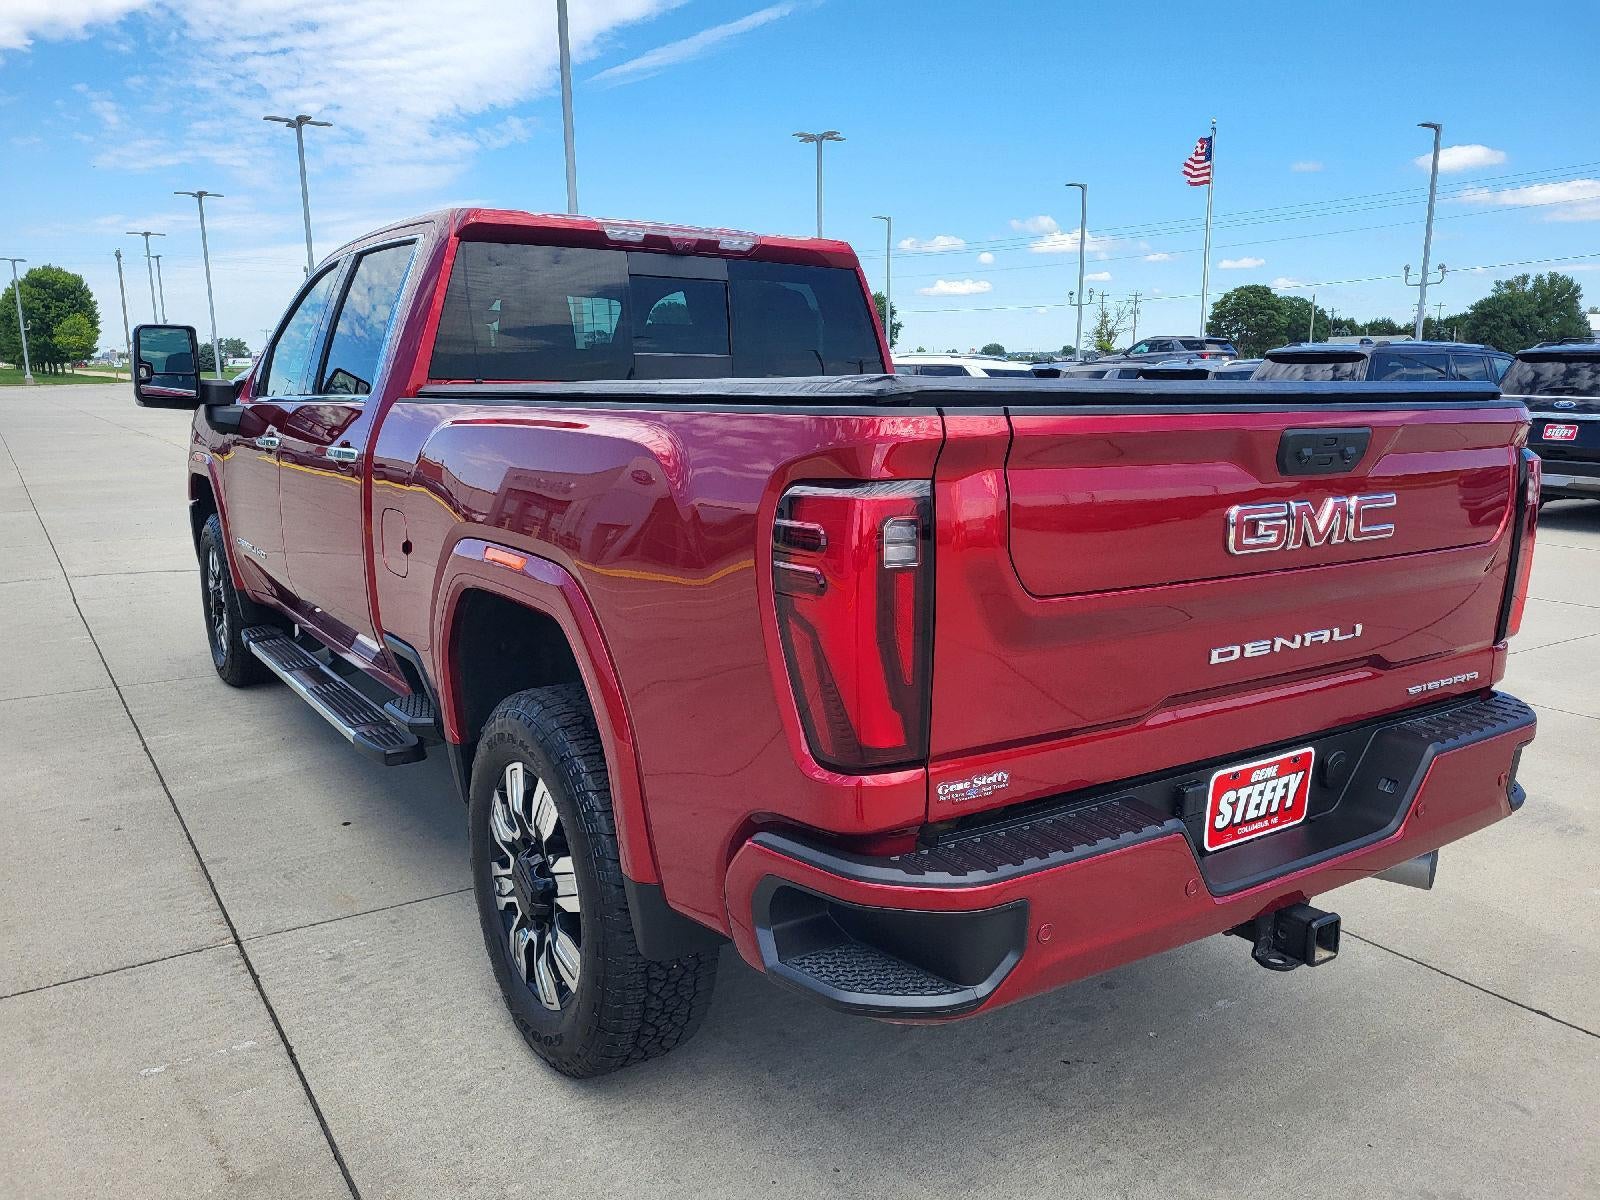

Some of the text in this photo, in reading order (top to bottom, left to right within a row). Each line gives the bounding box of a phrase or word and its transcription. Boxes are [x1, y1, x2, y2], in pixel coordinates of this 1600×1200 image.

[1546, 428, 1574, 436] STEFFY
[1226, 492, 1397, 555] GMC
[1209, 623, 1363, 665] DENALI
[1406, 671, 1479, 695] SIERRA
[937, 782, 971, 795] Gene
[972, 771, 1009, 788] Steffy
[1250, 765, 1279, 783] GENE
[1214, 771, 1305, 829] STEFFY
[1237, 817, 1279, 835] COLUMBUS, NE
